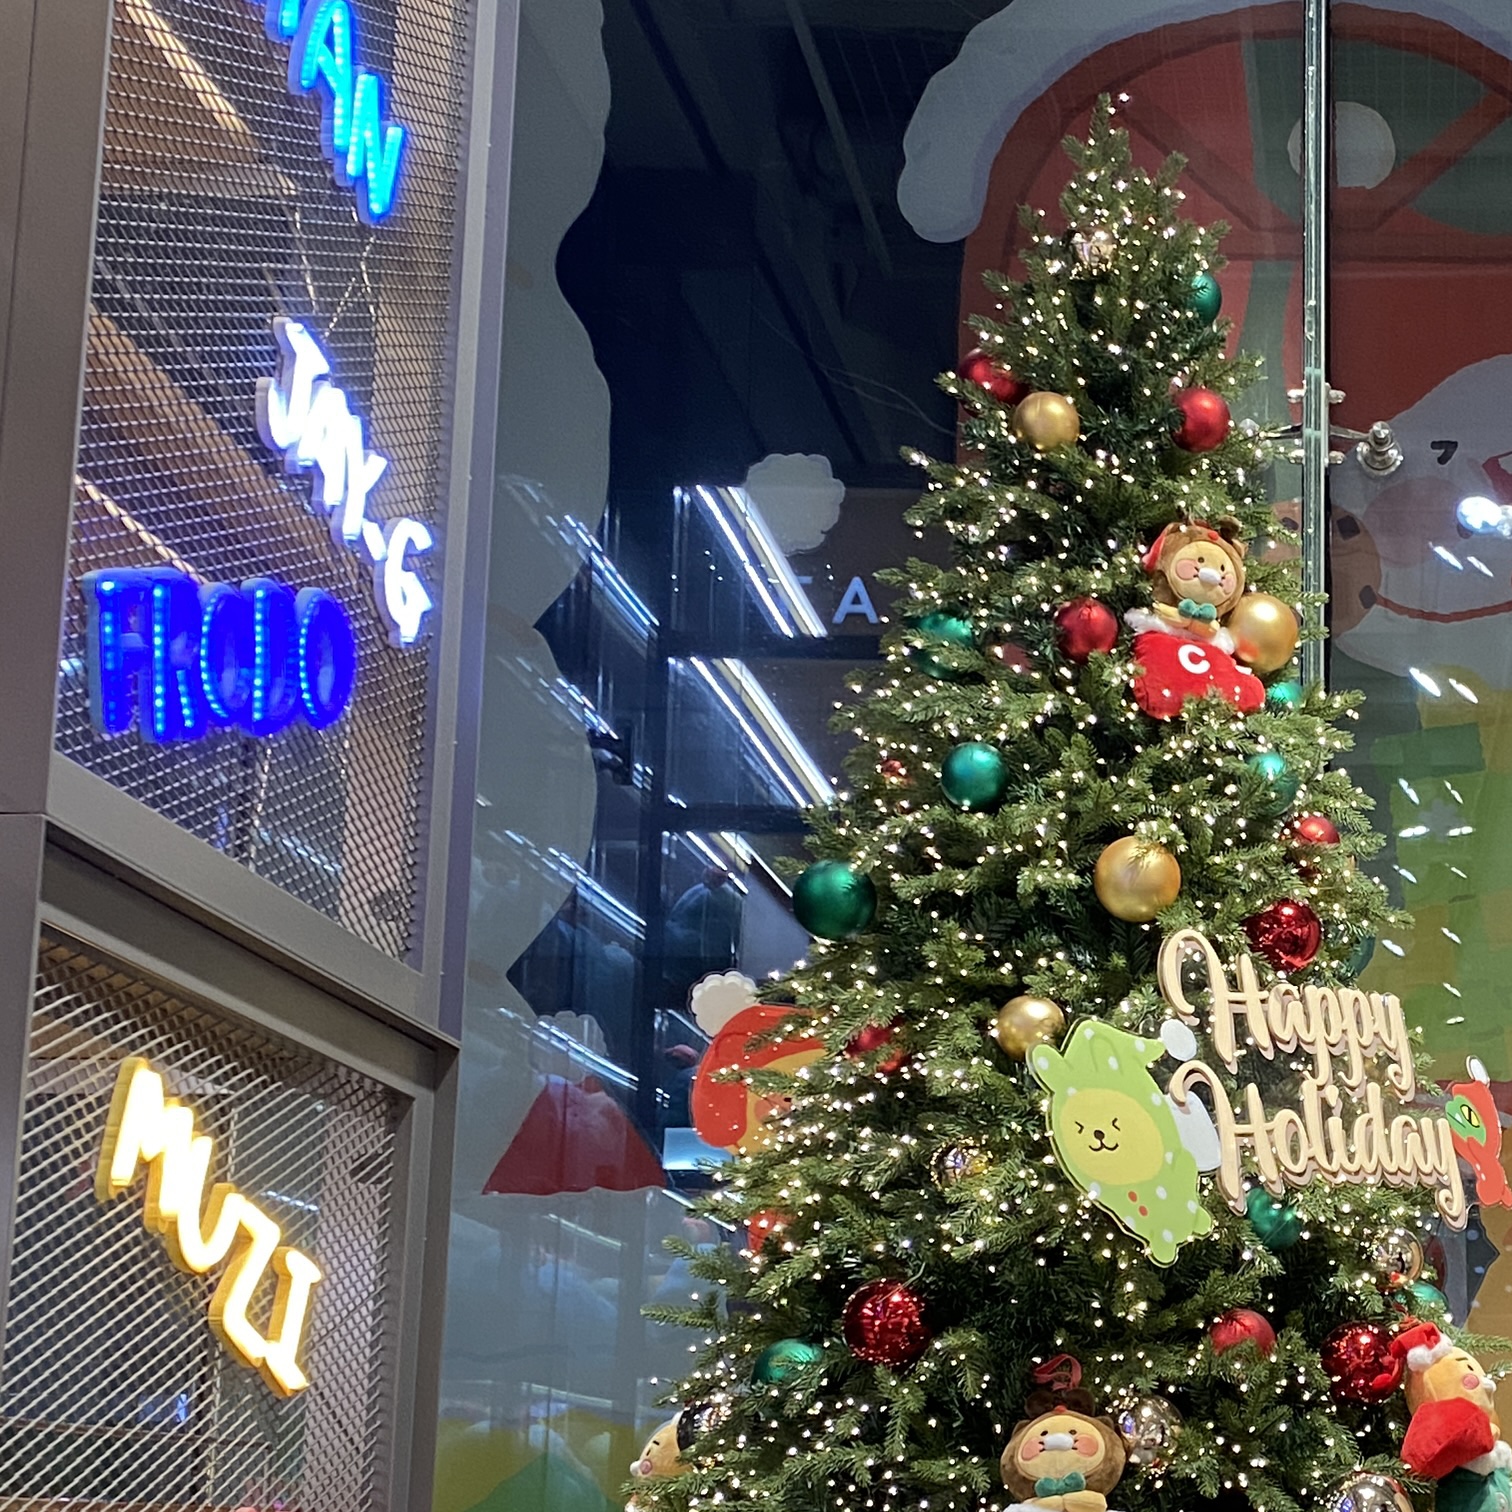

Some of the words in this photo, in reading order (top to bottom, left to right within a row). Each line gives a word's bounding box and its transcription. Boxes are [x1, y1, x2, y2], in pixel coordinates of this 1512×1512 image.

[268, 0, 407, 220] AN
[1177, 643, 1211, 675] C
[1157, 928, 1415, 1104] Happy
[98, 1057, 323, 1397] MUZI
[1169, 1059, 1468, 1231] Holiday
